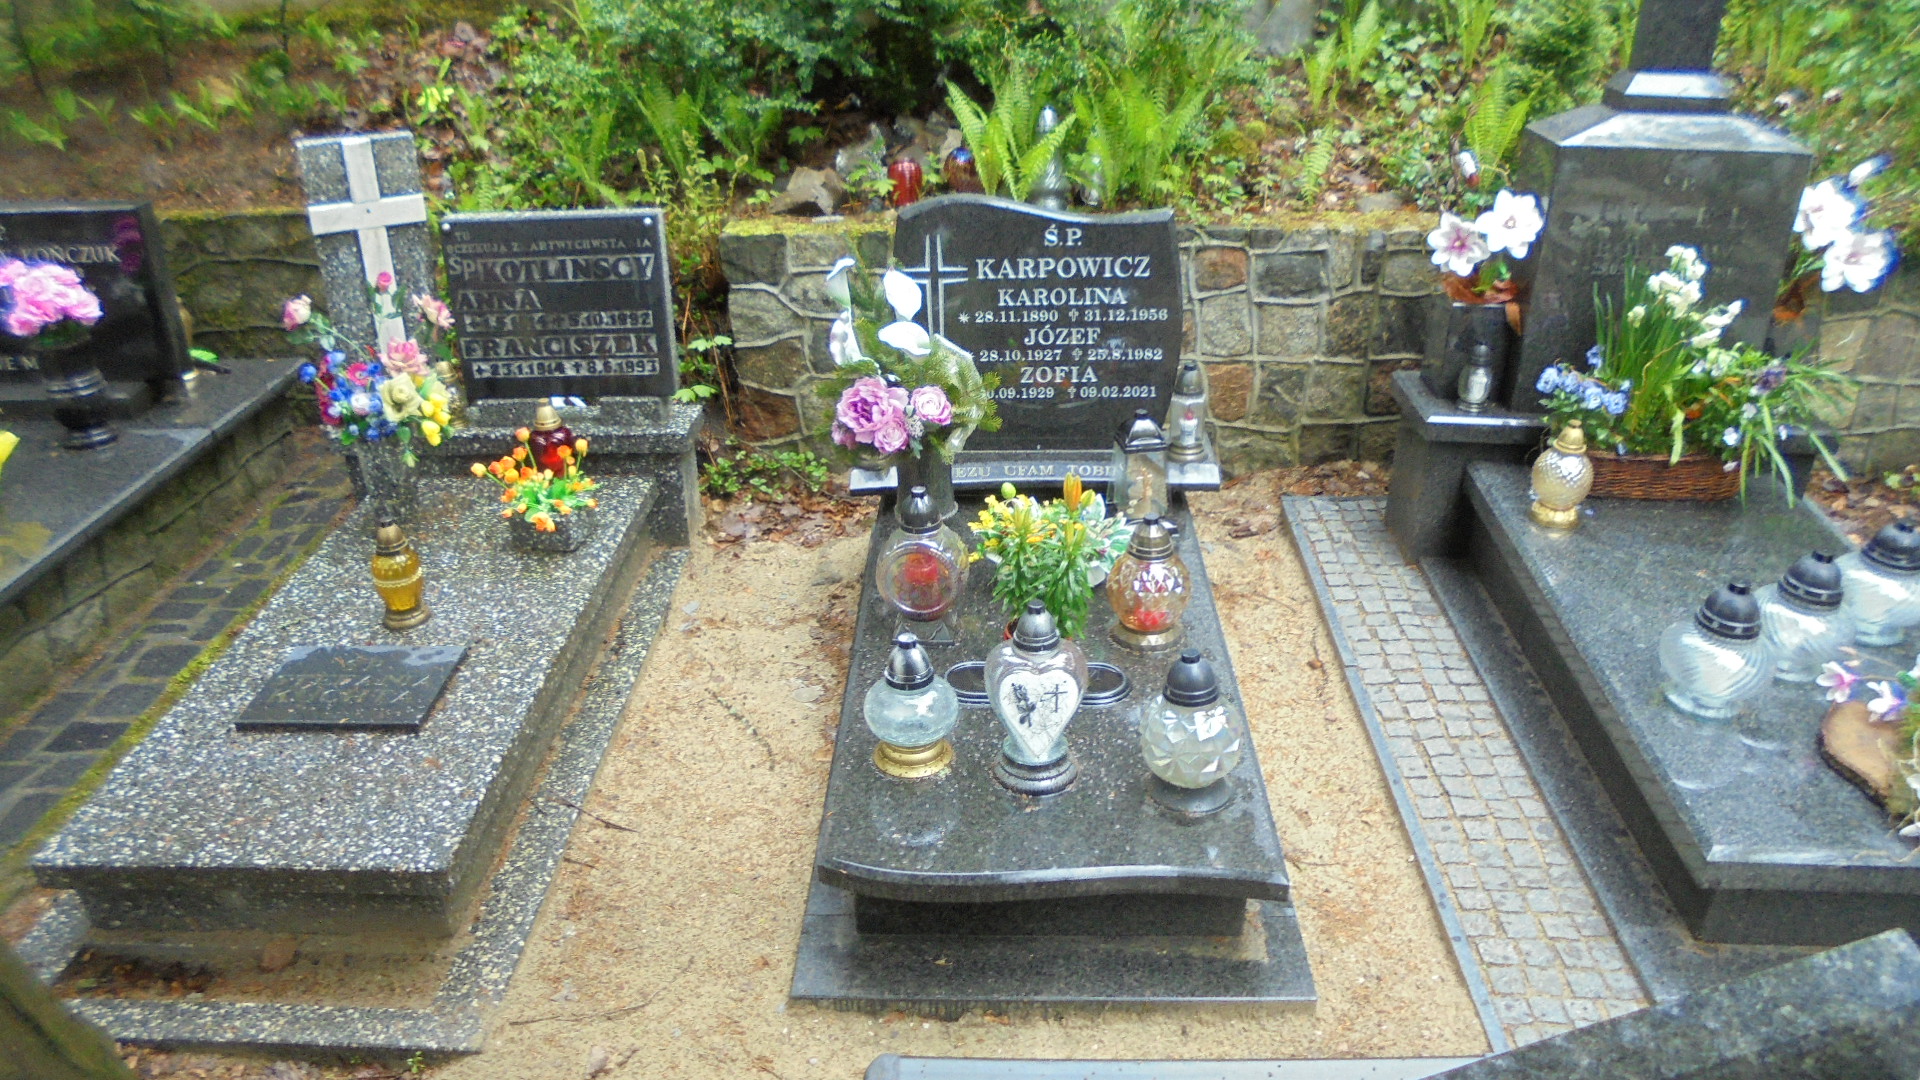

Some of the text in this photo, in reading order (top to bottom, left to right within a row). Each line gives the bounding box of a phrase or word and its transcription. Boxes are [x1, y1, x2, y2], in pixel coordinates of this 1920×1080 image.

[975, 256, 1150, 280] KARPOWICZ
[457, 289, 543, 310] ANNA
[998, 287, 1128, 306] KAROLINA
[975, 308, 1168, 323] 28.11.1890 31.12.1956
[1024, 324, 1101, 346] JÓZEF
[980, 349, 1062, 362] 28.10.1927
[1020, 365, 1098, 383] ZOFIA
[1080, 386, 1157, 398] 09.02.2021
[951, 466, 991, 478] EZU
[1004, 465, 1055, 476] UFAM
